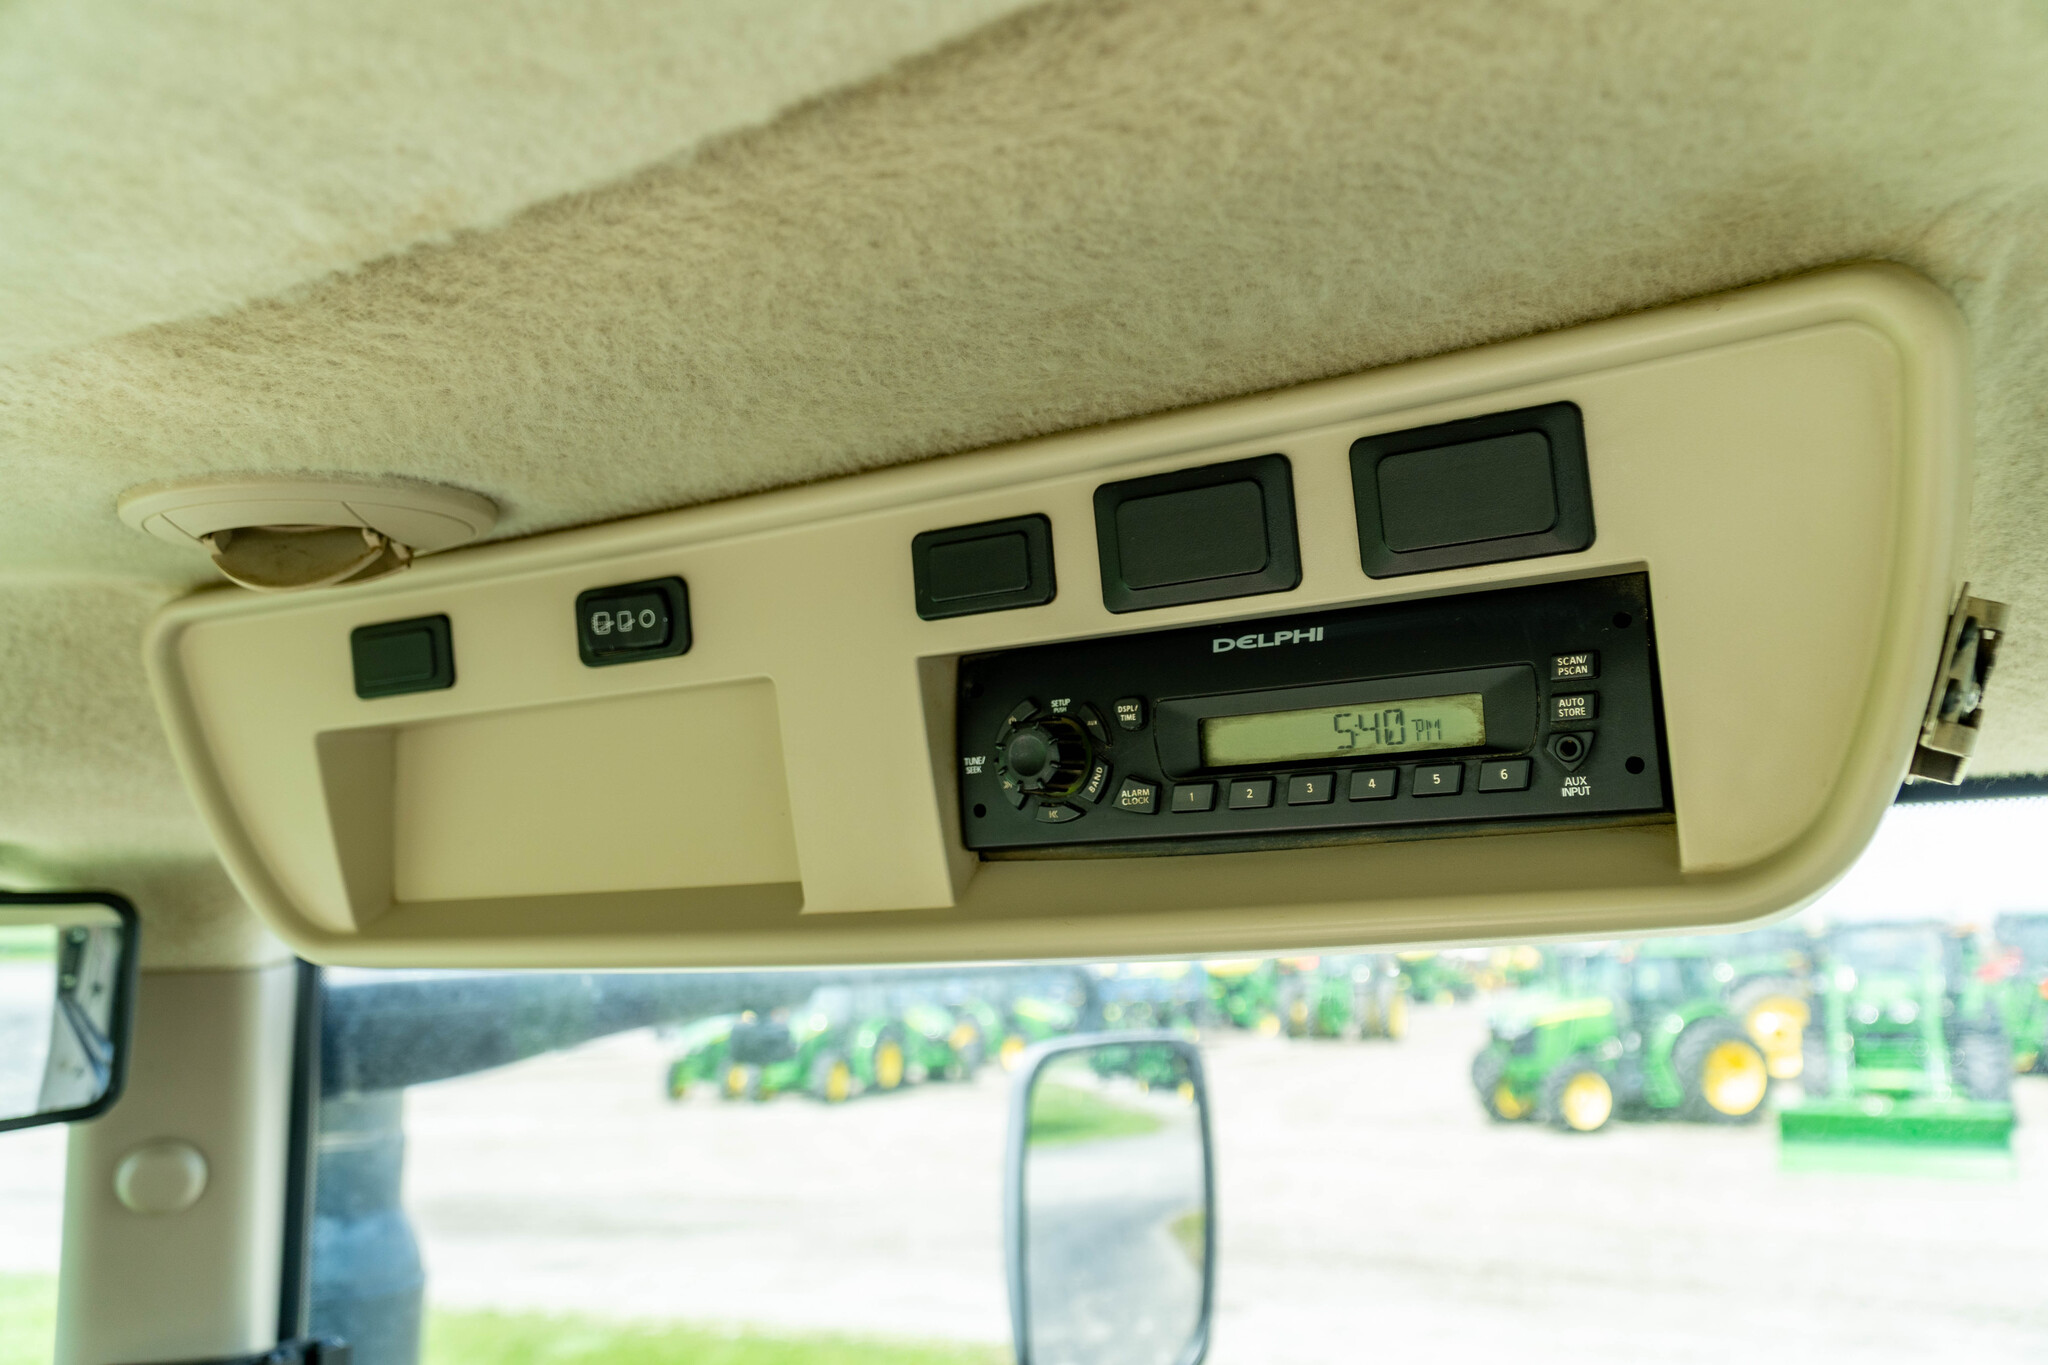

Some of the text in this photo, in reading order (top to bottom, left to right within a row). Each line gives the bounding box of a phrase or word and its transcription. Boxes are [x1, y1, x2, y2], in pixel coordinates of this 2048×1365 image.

[1213, 627, 1324, 653] DELPHI
[1557, 655, 1587, 666] SCAN/
[1558, 665, 1588, 676] PSCAN
[1051, 699, 1071, 708] SETUP
[1559, 698, 1585, 708] AUTO
[1117, 705, 1138, 713] DSPL/
[1558, 707, 1586, 717] STORE
[1120, 714, 1136, 722] TIME
[1333, 709, 1442, 750] 5:40 PM
[964, 756, 986, 766] TUNE/
[966, 765, 982, 774] SEEK
[1500, 769, 1509, 780] 6
[1088, 766, 1104, 794] BAND
[1368, 778, 1377, 790] 4
[1433, 773, 1441, 785] 5
[1564, 776, 1588, 786] AUX
[1121, 789, 1150, 798] ALARM
[1246, 788, 1254, 799] 2
[1306, 783, 1314, 794] 3
[1561, 786, 1592, 797] INPUT
[1122, 797, 1150, 806] CLOCK
[1189, 792, 1195, 802] 1
